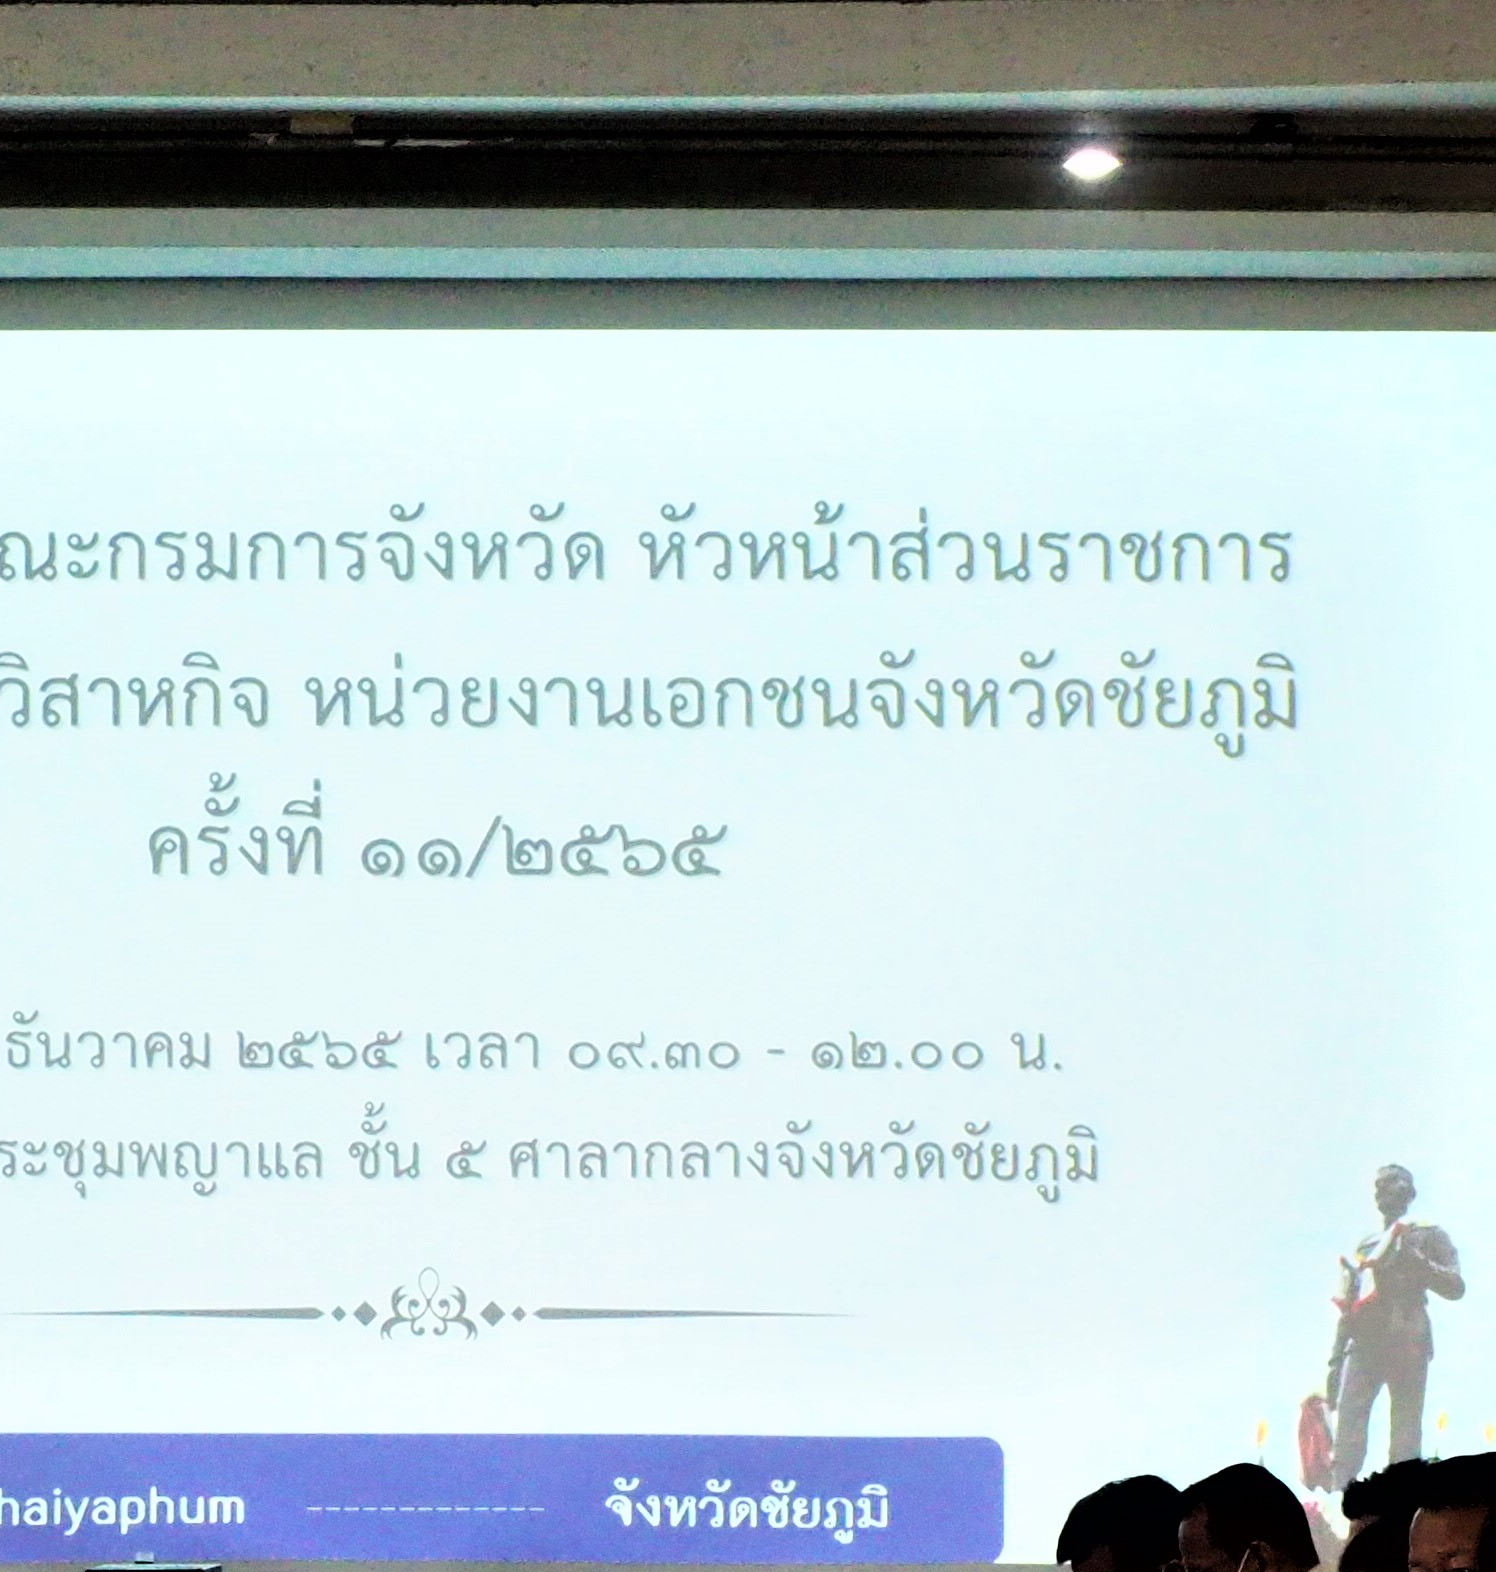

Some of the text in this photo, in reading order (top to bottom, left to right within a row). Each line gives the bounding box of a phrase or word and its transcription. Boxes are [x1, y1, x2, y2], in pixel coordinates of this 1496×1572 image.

[637, 499, 1294, 584] หัวหน้าส่วนราชการ
[303, 647, 1301, 760] หน่วยงานเอกชนจังหวัดชัยภูมิ
[148, 771, 729, 880] ครั้งที่ ๑๑/๒๕๖๕
[5, 1009, 212, 1071] ธันวาคม
[236, 1030, 403, 1071] ๒๕๖๕
[425, 1031, 540, 1071] เวลา
[568, 1031, 741, 1071] ๐๙.๓๐
[811, 1030, 985, 1071] ๑๒.๐๐
[1010, 1031, 1063, 1072] น.
[348, 1101, 421, 1181] ชั้น
[445, 1139, 488, 1181] ๕
[509, 1119, 1100, 1205] ศาลากลางจังหวัดชัยภูมิ
[605, 1477, 889, 1544] จังหวัดชัยภูมิ
